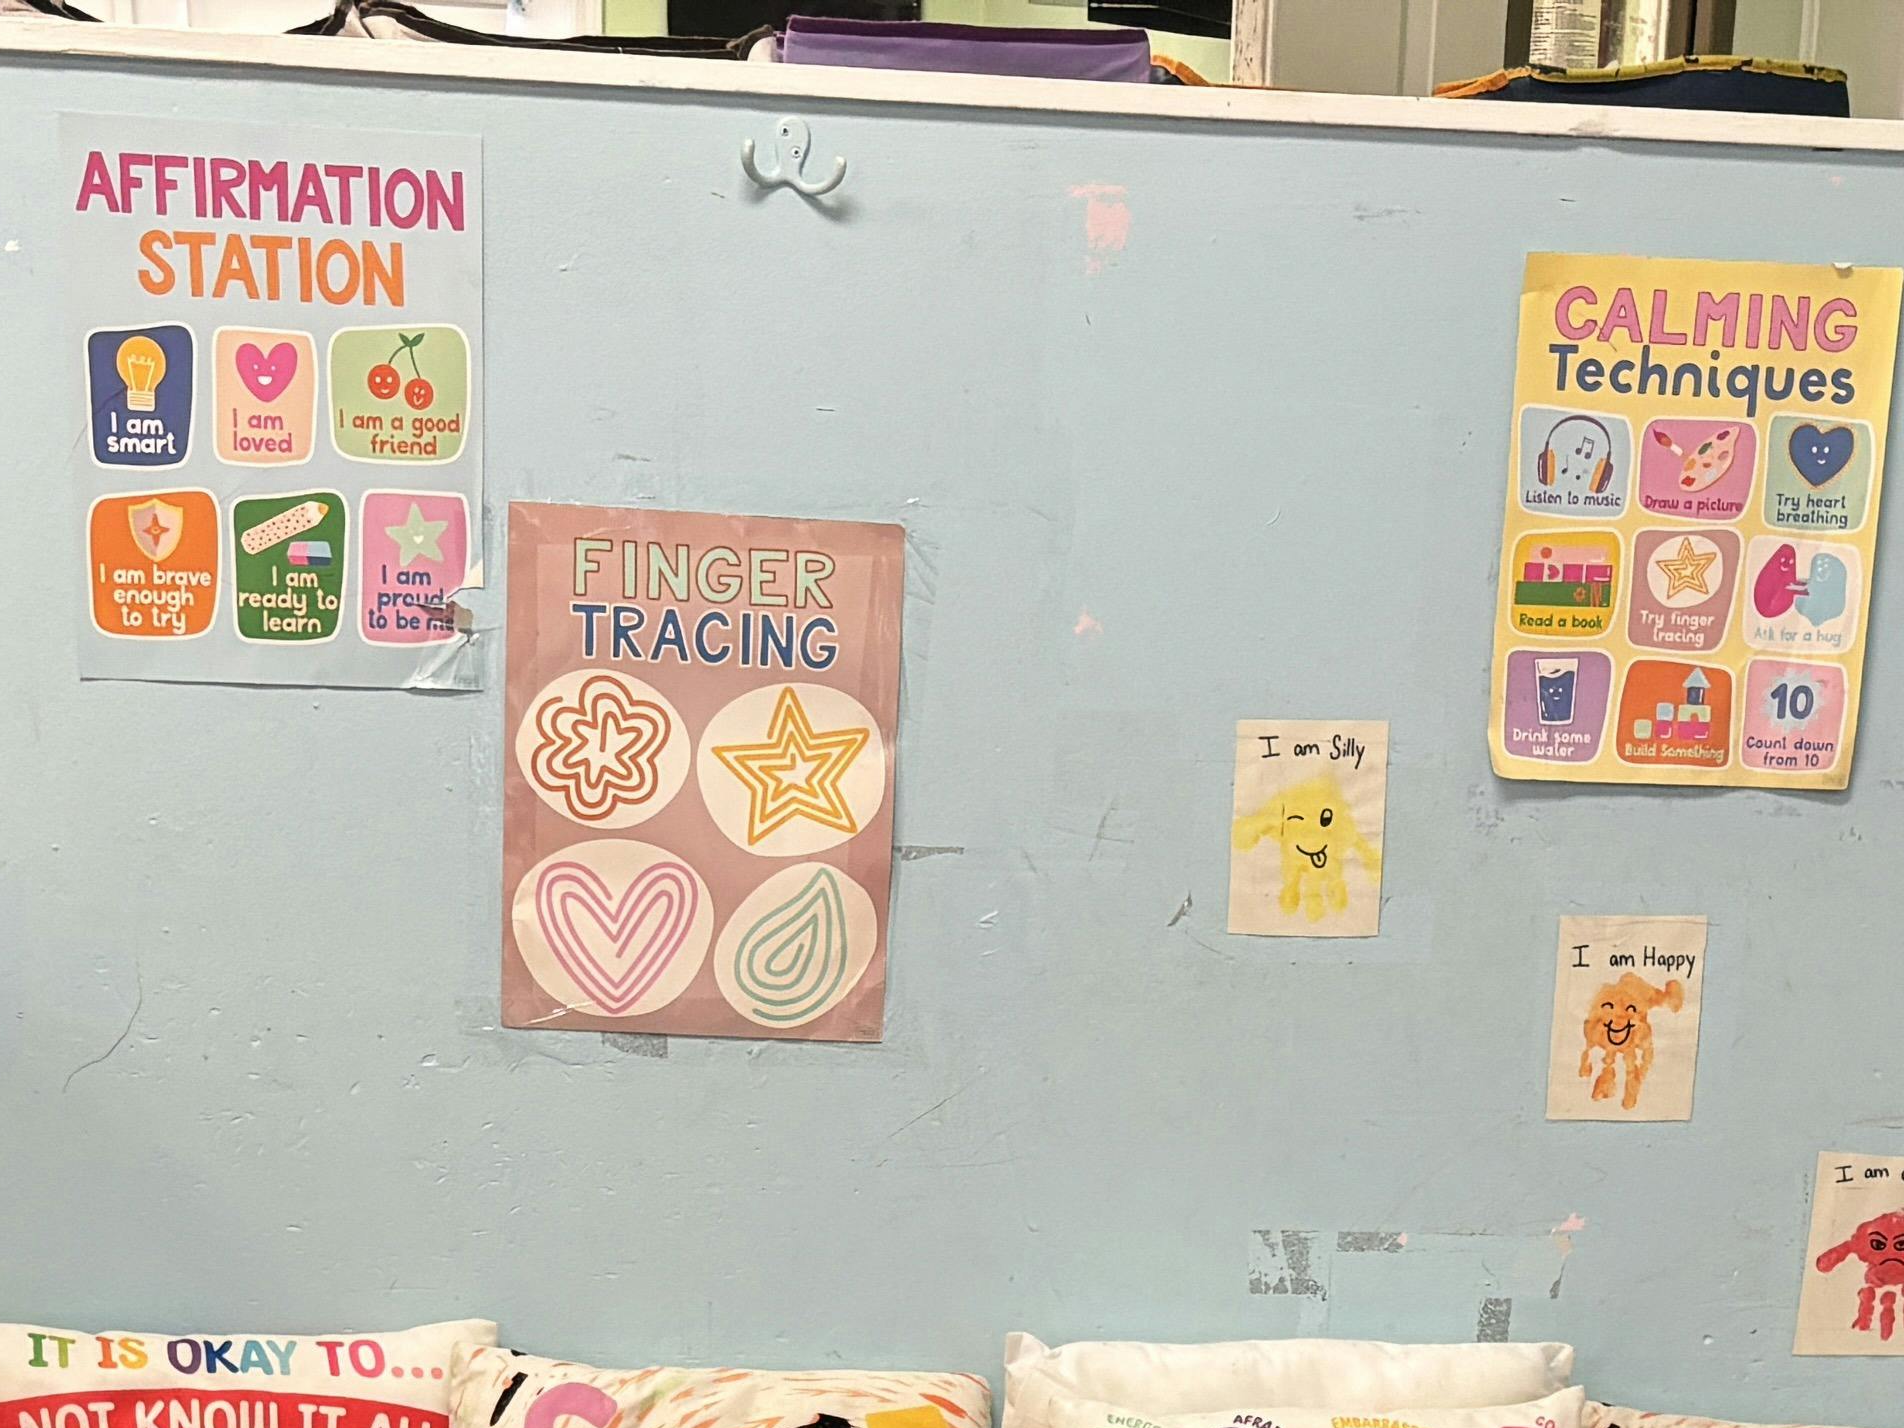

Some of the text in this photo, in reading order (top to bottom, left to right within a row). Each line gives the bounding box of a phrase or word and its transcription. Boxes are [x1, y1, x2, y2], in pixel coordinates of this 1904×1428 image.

[75, 151, 465, 231] AFFIRMATION
[138, 229, 404, 307] STATION
[1555, 286, 1858, 352] CALMING
[1549, 344, 1855, 418] Techniques
[110, 411, 164, 436] I am
[232, 409, 283, 430] I am
[339, 410, 461, 439] I am a good
[107, 432, 177, 455] smart
[232, 430, 292, 454] loved
[370, 432, 438, 456] friend
[1526, 490, 1621, 508] Listen to music
[1644, 495, 1744, 516] Draw a picture
[1777, 493, 1846, 514] Try heart
[1776, 510, 1849, 529] breathing
[100, 564, 212, 587] I am brave
[573, 537, 836, 610] FINGER
[113, 587, 194, 613] enough
[121, 606, 187, 635] to try
[1519, 613, 1603, 630] Read a book
[571, 602, 839, 671] TRACING
[1258, 734, 1365, 770] I am Silly
[1572, 944, 1696, 979] I am Happy
[1834, 1165, 1854, 1184] I
[1864, 1167, 1889, 1179] am
[27, 1333, 443, 1380] IT IS OKAY TO...
